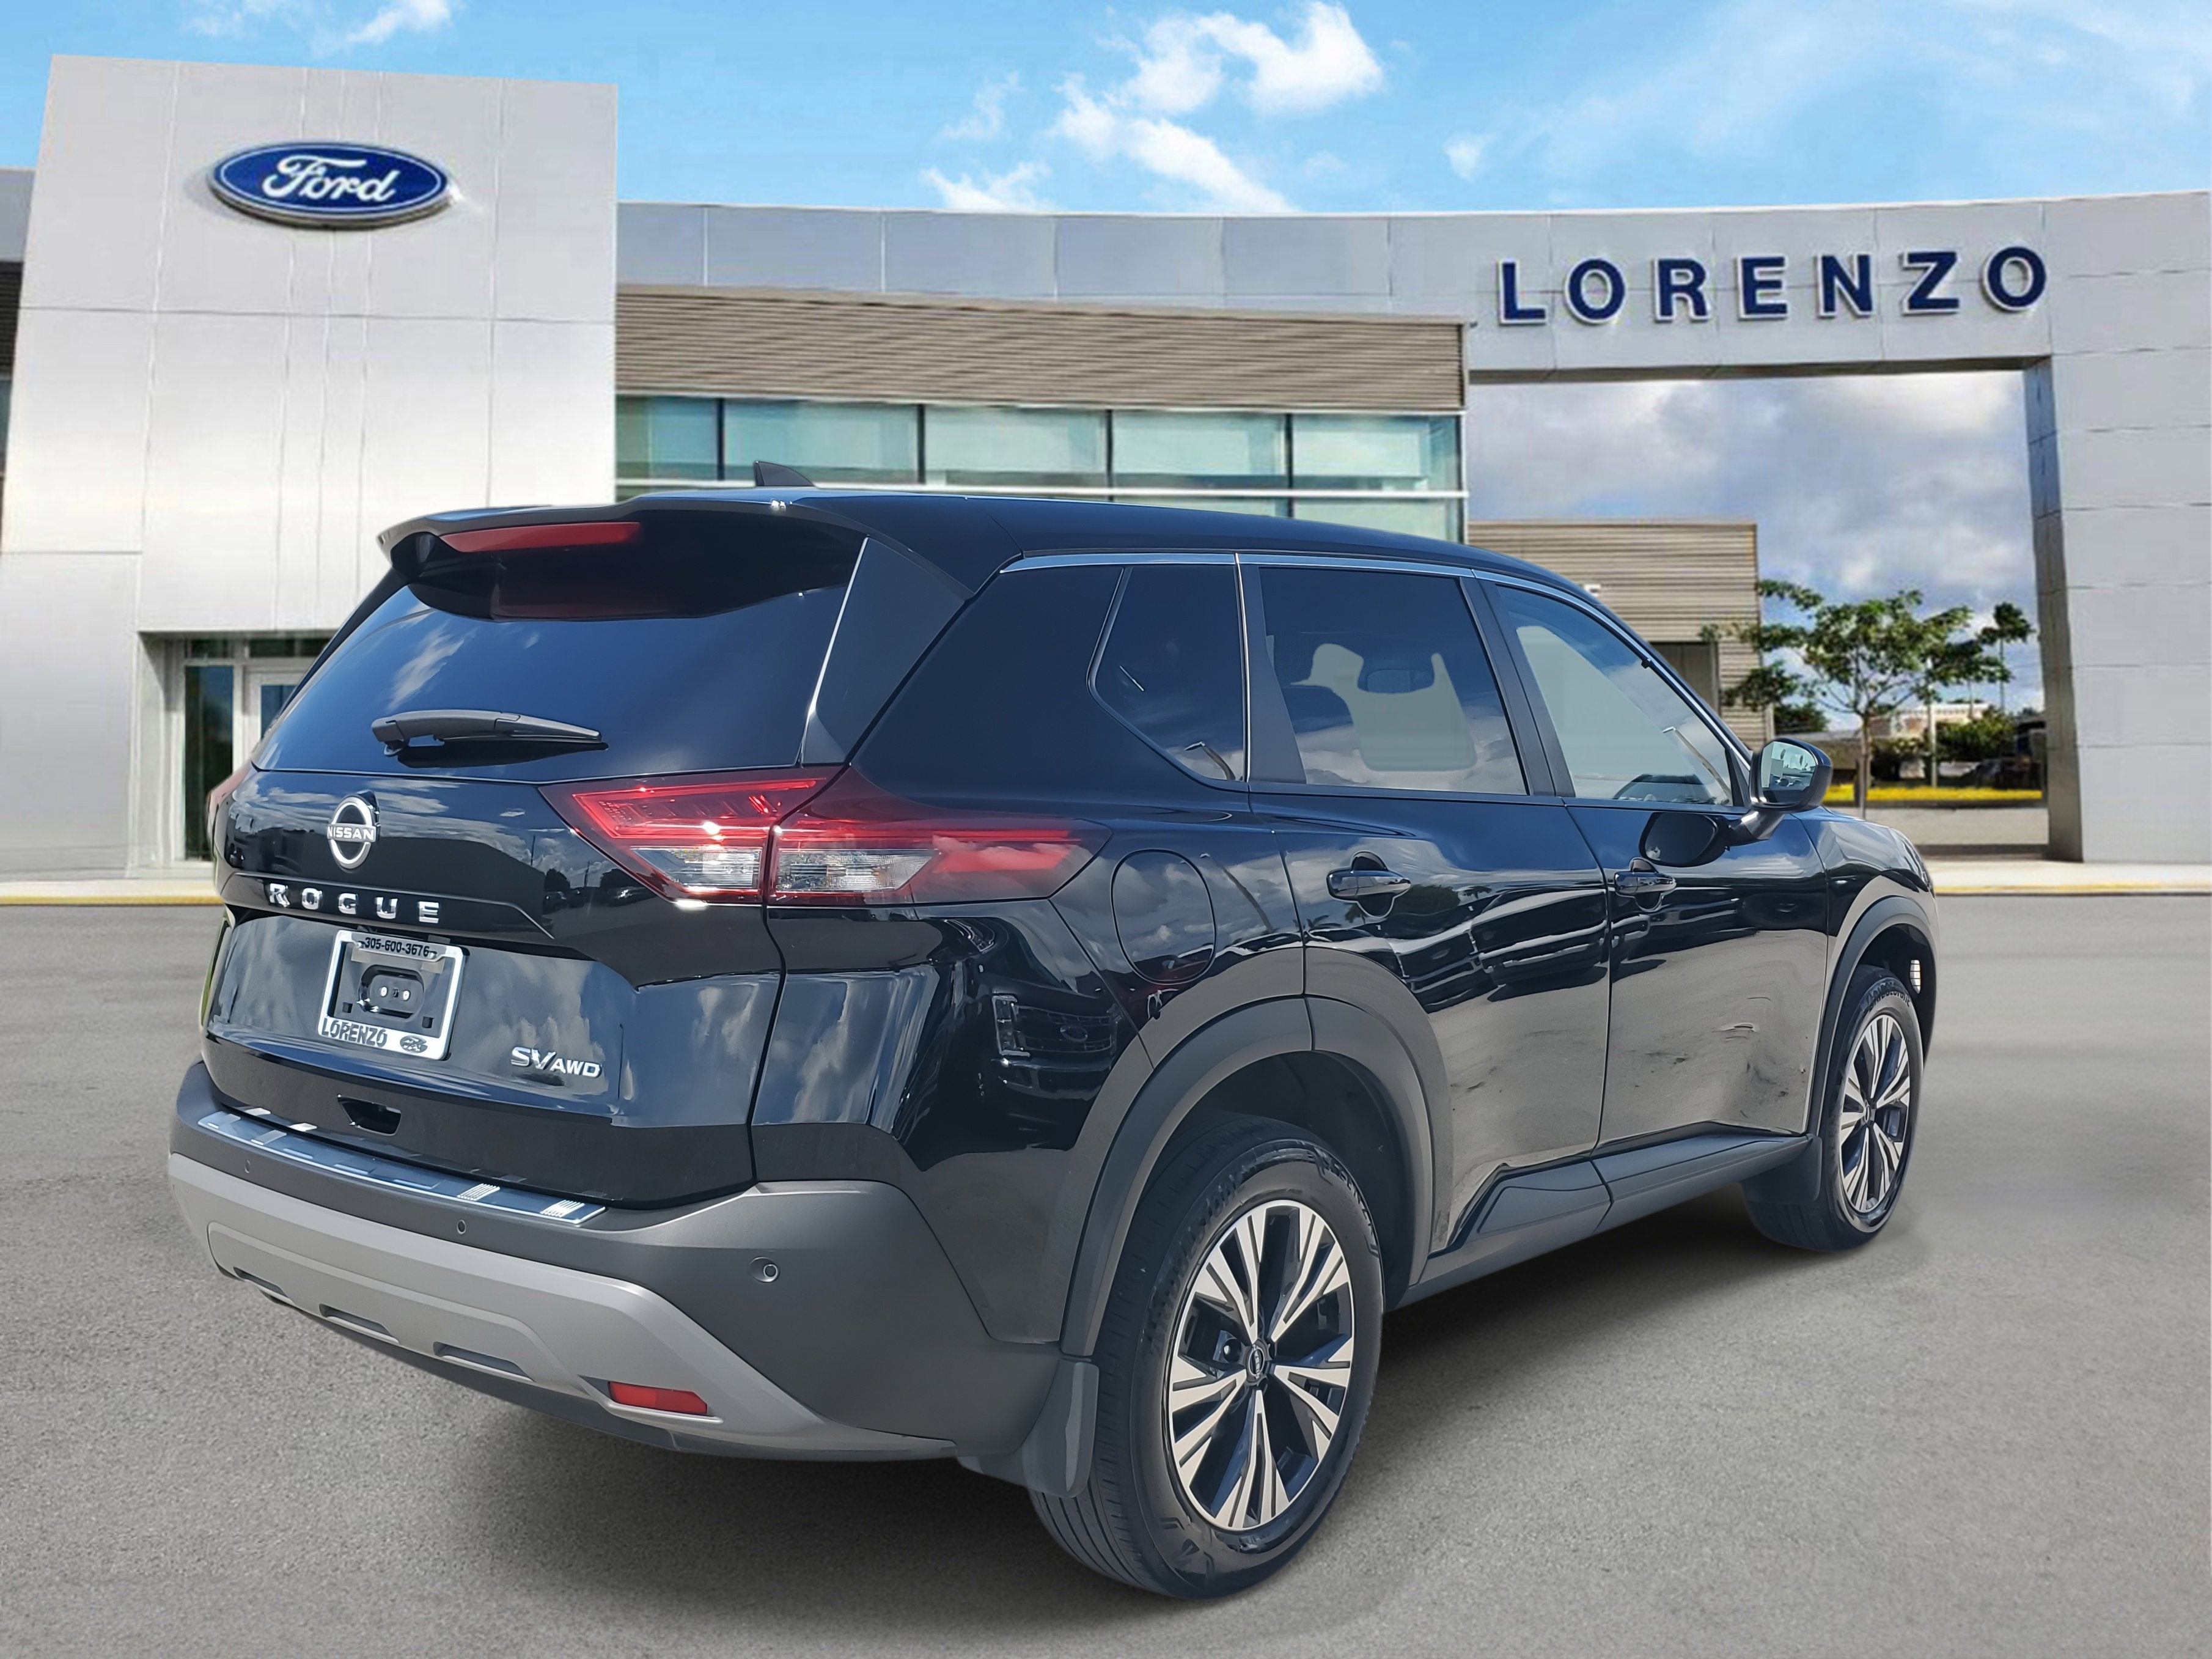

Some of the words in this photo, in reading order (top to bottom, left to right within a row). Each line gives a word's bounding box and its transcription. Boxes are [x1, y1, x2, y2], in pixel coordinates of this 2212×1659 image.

[262, 154, 400, 202] Ford
[1498, 246, 2047, 324] LORENZO
[327, 826, 374, 841] NISSAN
[270, 883, 439, 924] ROGUE
[364, 937, 430, 957] 305-600-3676
[322, 1017, 388, 1048] LORENZO
[550, 1058, 601, 1078] AWD
